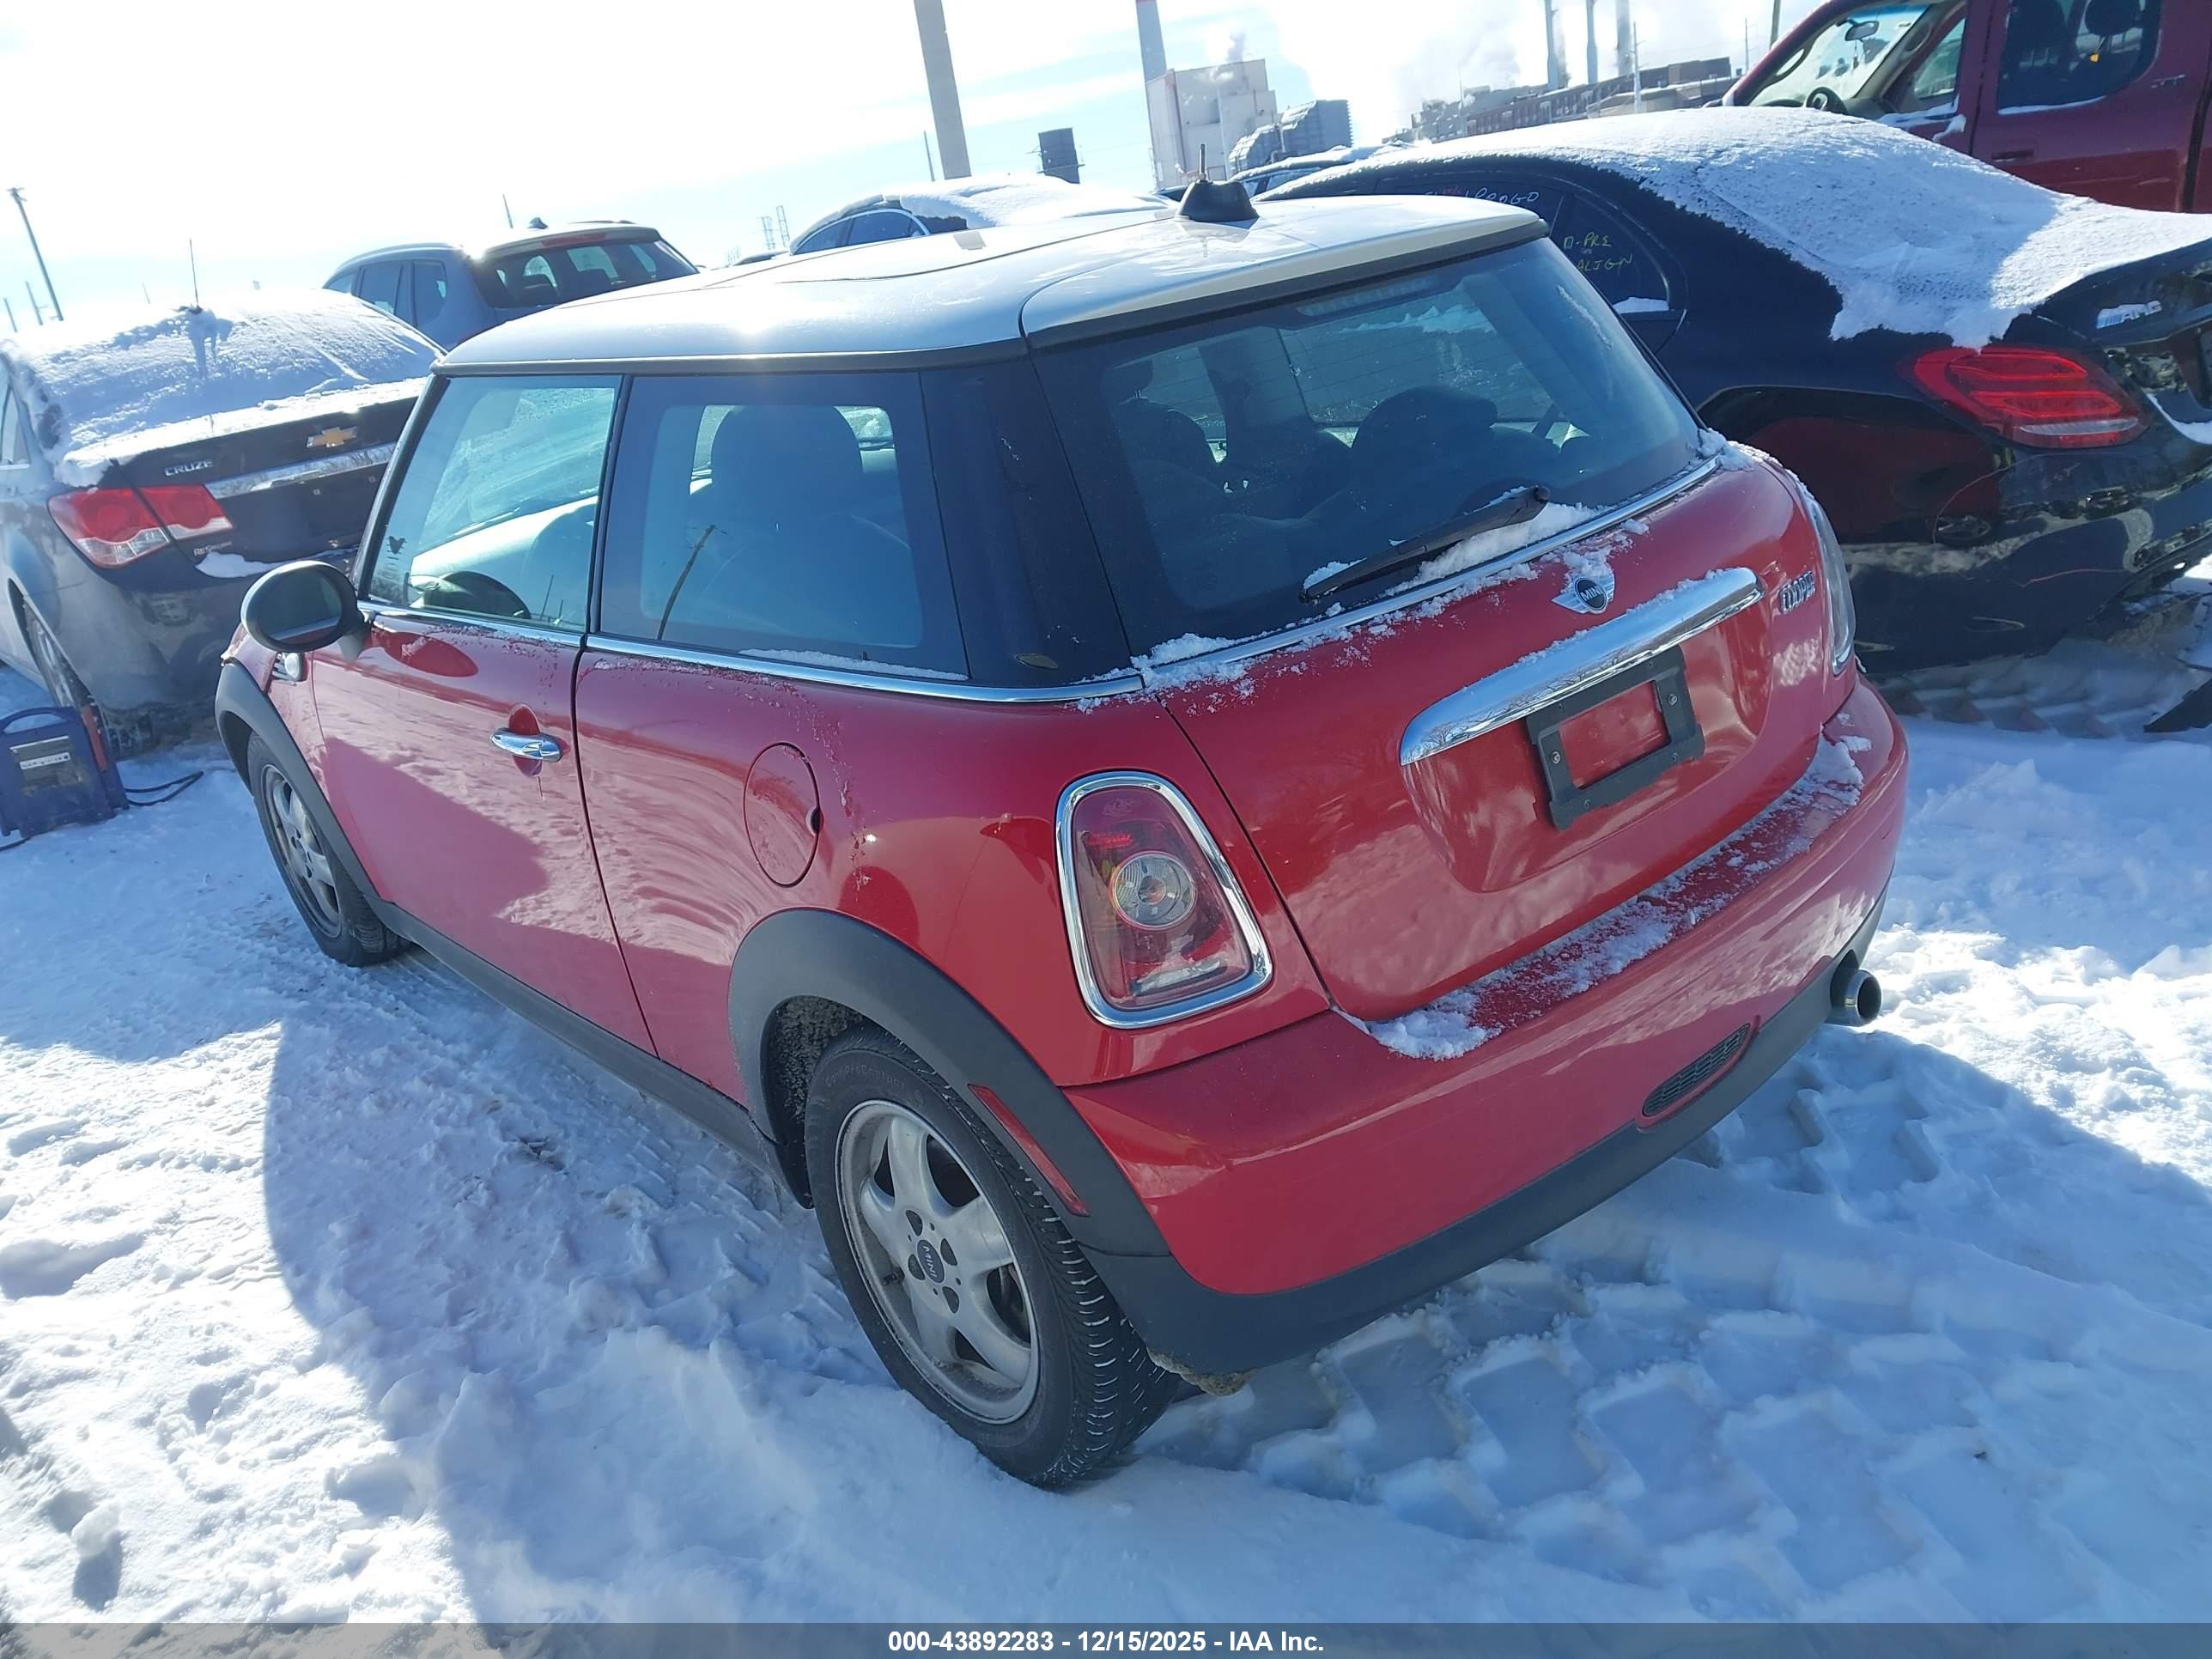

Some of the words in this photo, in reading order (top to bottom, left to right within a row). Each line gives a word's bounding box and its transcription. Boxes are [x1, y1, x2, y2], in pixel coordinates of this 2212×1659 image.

[164, 459, 214, 477] CRUZE
[1580, 585, 1603, 602] MINI
[922, 1245, 938, 1278] MINI
